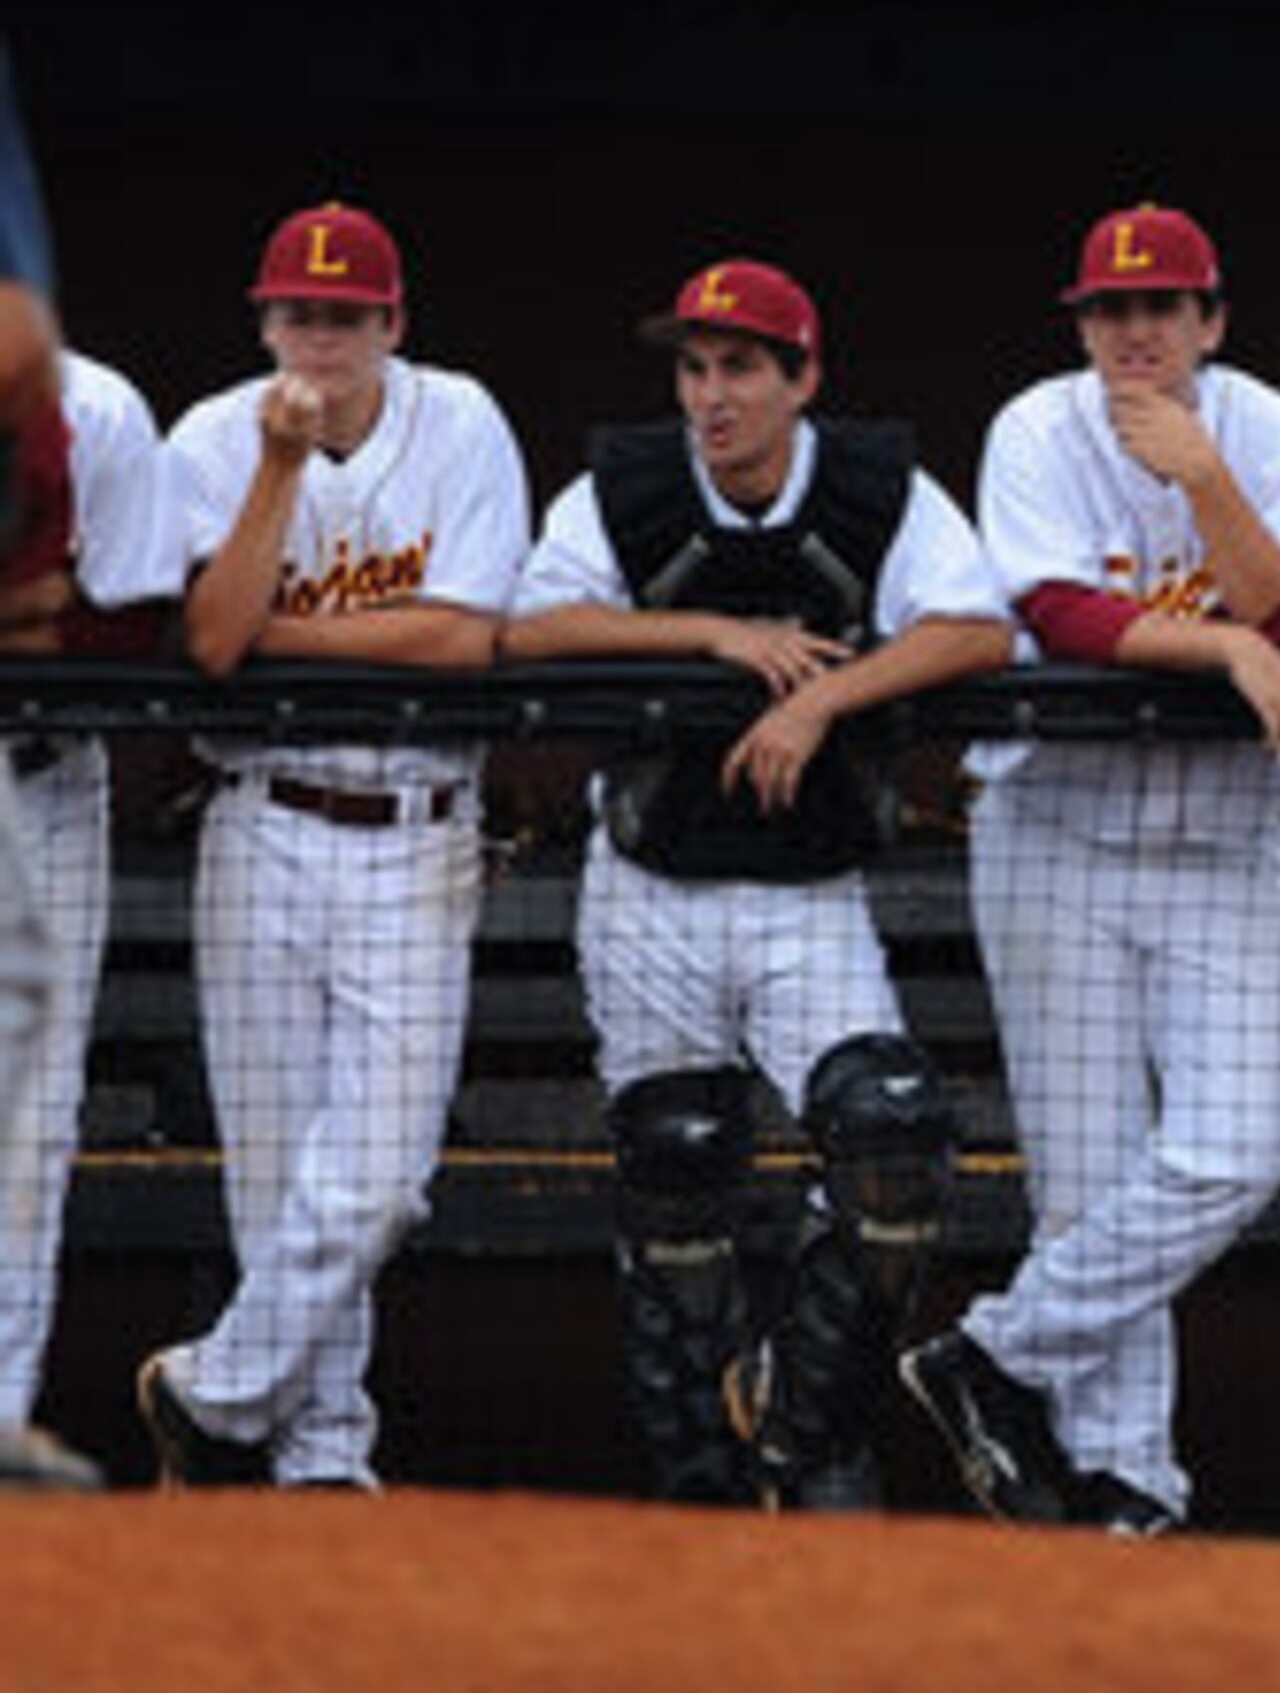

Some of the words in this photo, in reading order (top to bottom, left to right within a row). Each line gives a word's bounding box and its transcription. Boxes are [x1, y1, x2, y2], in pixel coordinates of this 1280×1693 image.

[305, 224, 350, 276] L
[1112, 222, 1154, 272] L
[699, 269, 738, 312] L
